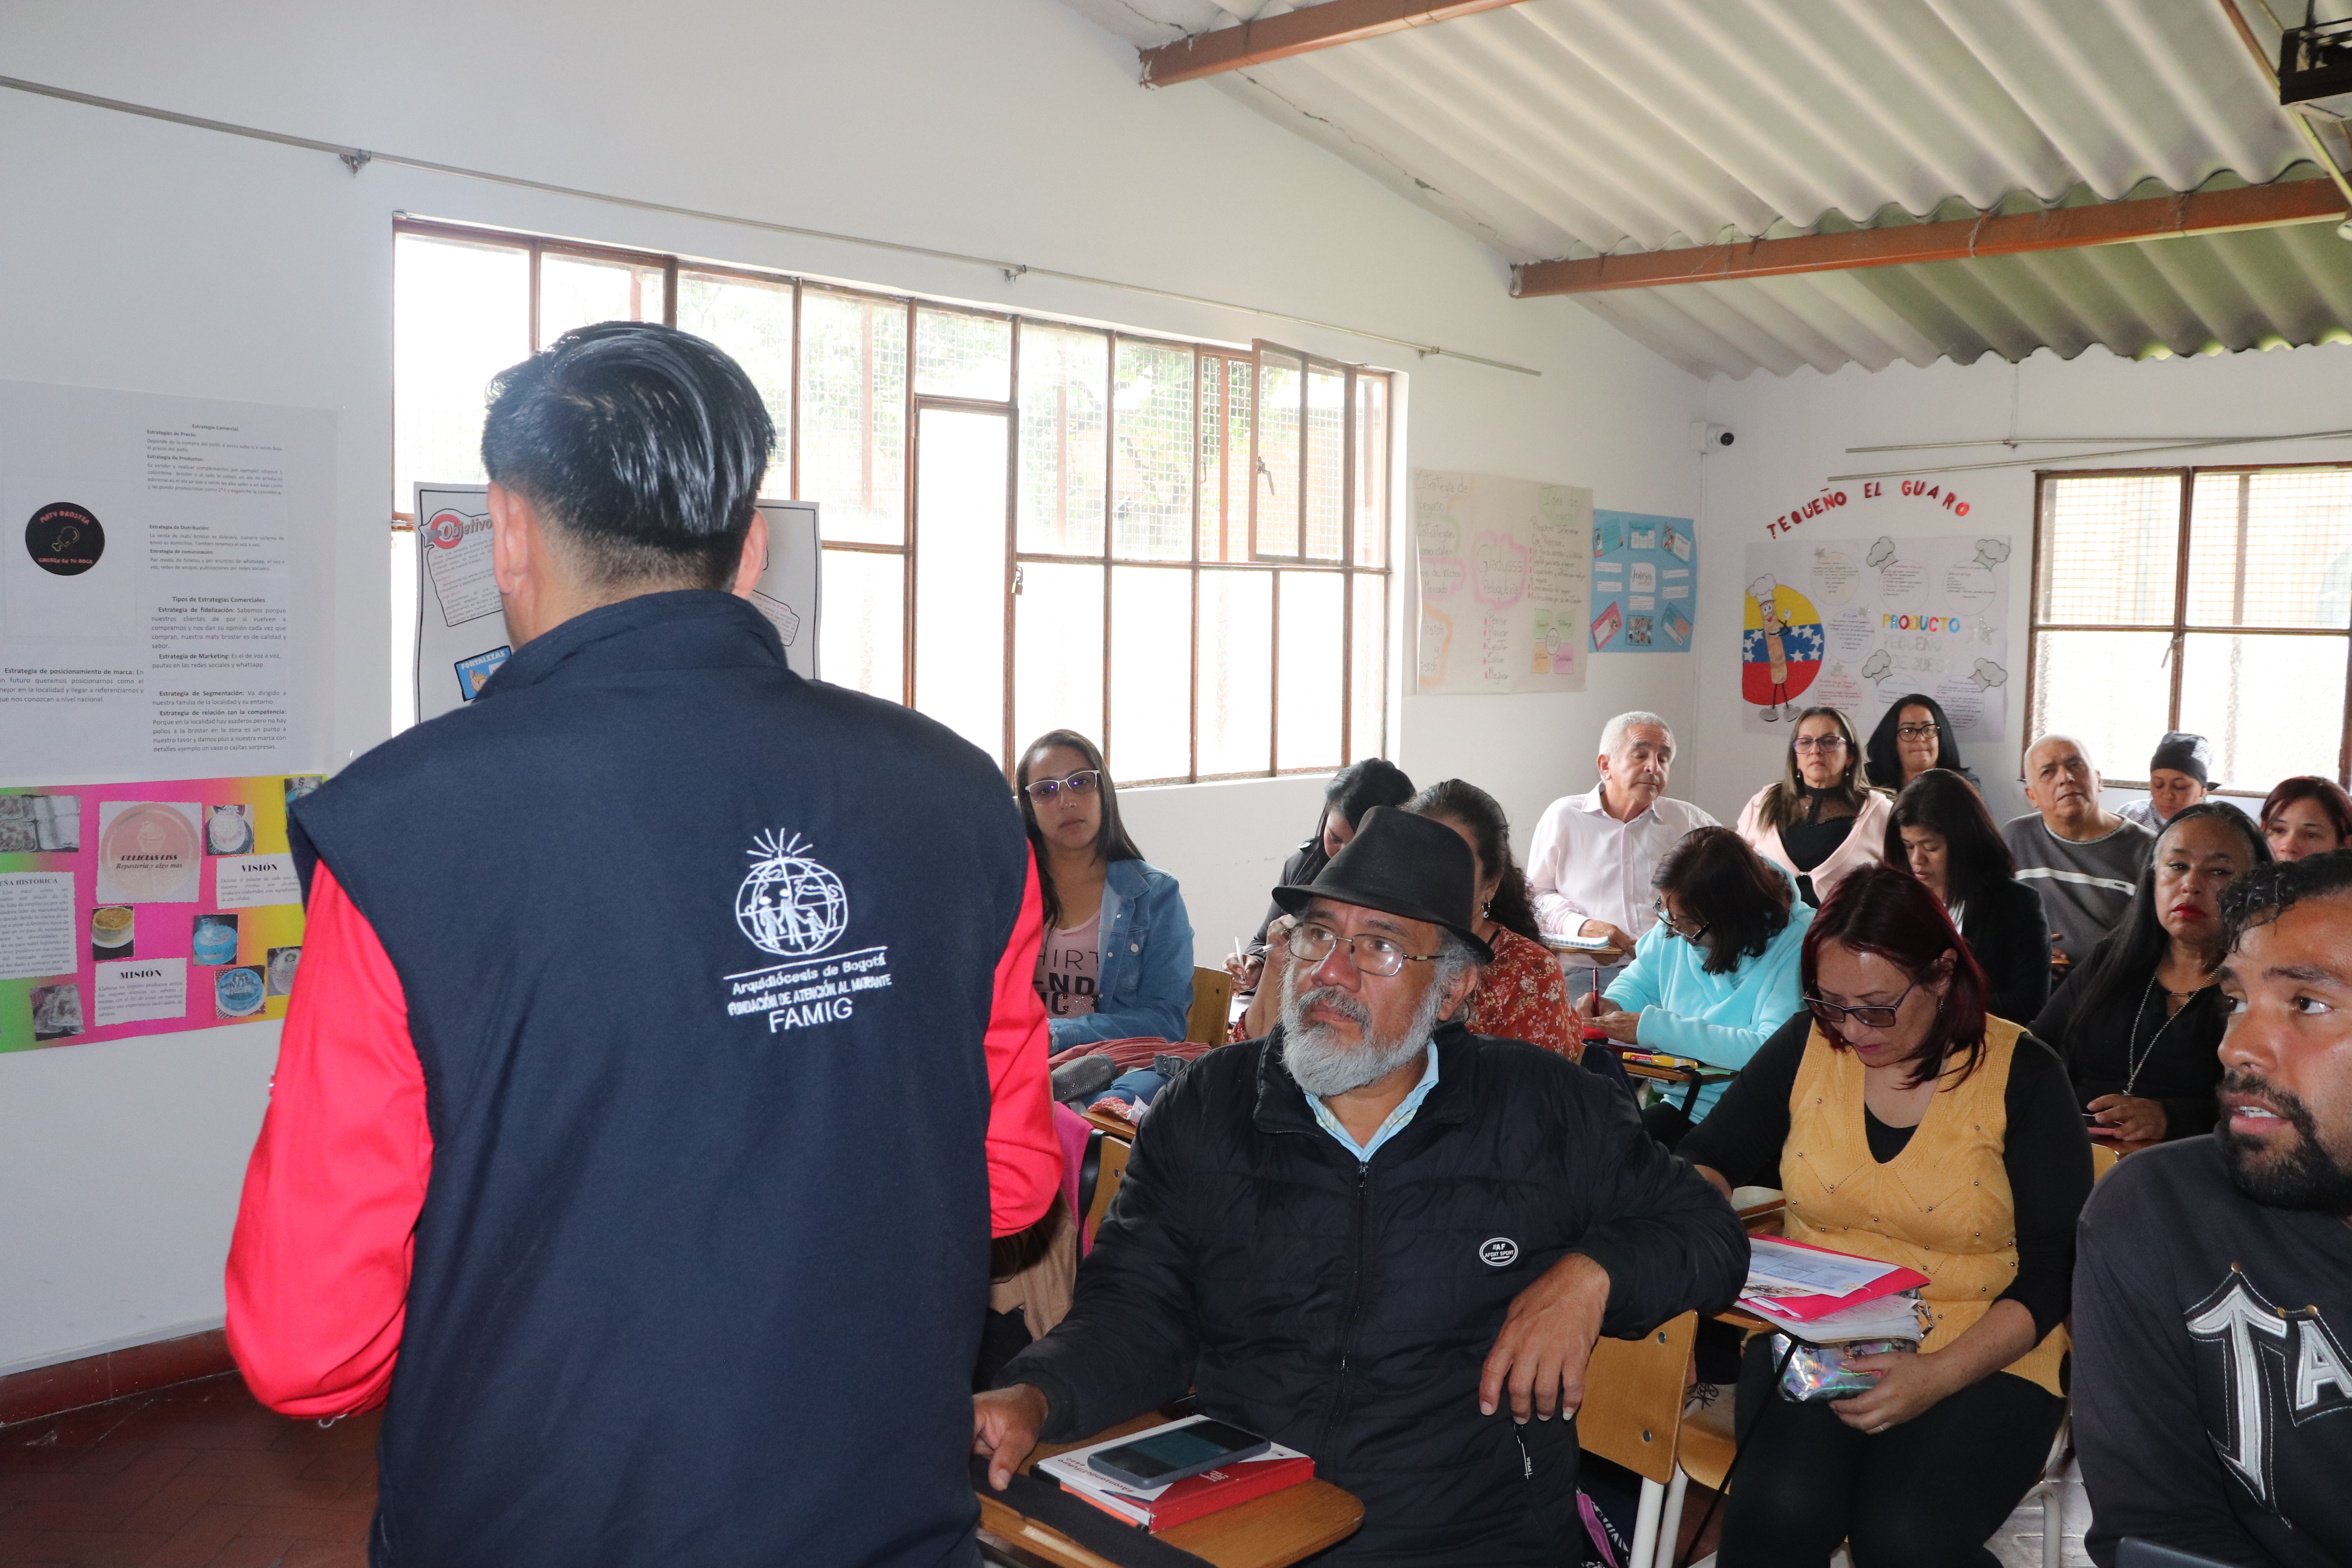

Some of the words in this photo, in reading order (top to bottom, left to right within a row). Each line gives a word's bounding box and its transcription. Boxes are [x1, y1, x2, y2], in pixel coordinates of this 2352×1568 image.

[1458, 475, 1468, 494] de
[1766, 488, 1847, 539] TEQUEÑO
[1864, 481, 1882, 498] EL
[1901, 481, 1970, 516] GUARO
[1882, 613, 1960, 633] PRODUCTO
[461, 650, 506, 670] FORTALEZAS
[1420, 661, 1437, 671] isión
[241, 862, 278, 872] VISIÓN
[120, 968, 162, 979] MISIÓN
[732, 968, 818, 996] Arquidiócesis
[823, 965, 839, 977] de
[842, 952, 887, 973] Bogotá
[1033, 973, 1095, 995] ND
[728, 991, 779, 1016] FUNDACIÓN
[778, 992, 792, 1005] DE
[793, 979, 837, 1003] ATENCIÓN
[838, 980, 851, 994] AL
[851, 974, 892, 992] MIGRANTE
[769, 997, 853, 1034] FAMIG
